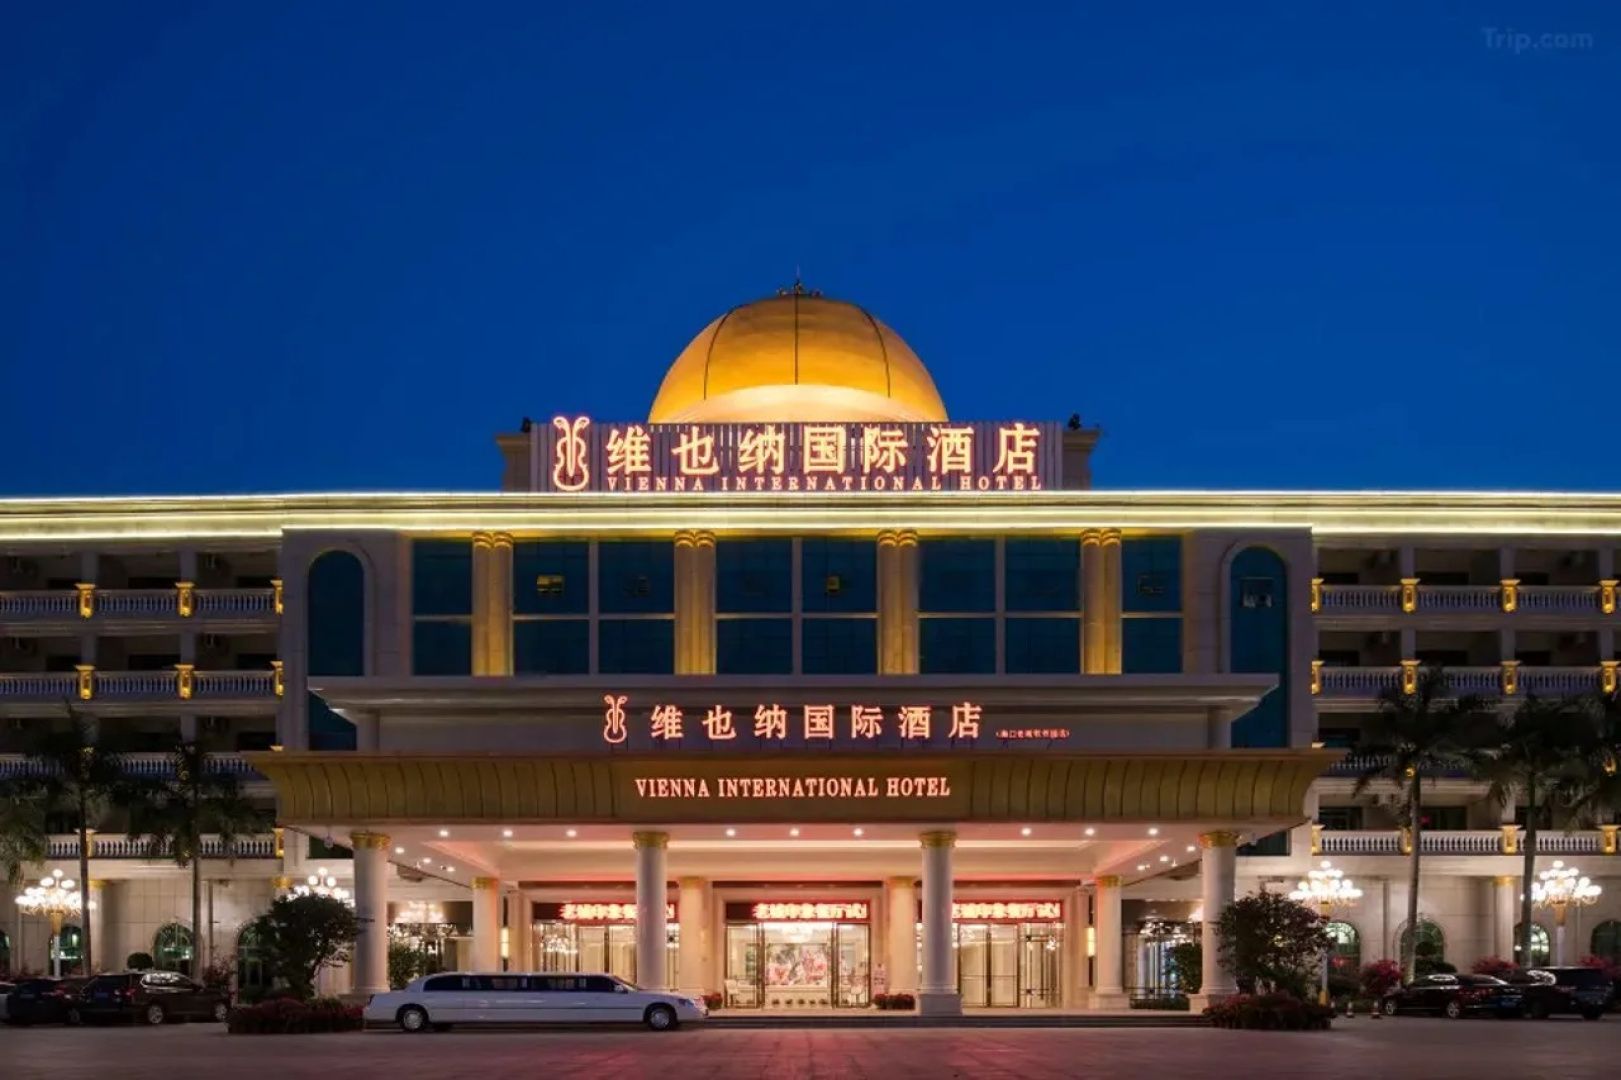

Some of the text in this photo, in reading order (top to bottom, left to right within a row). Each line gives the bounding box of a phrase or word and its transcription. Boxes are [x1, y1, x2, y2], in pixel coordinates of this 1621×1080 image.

[606, 422, 1041, 475] 维也纳国际酒店
[606, 476, 1042, 491] VIENNA INTERNATIONAL HOTEL
[650, 702, 982, 740] 维也纳国际酒店
[635, 777, 950, 797] VIENNA INTERNATIONAL HOTEL
